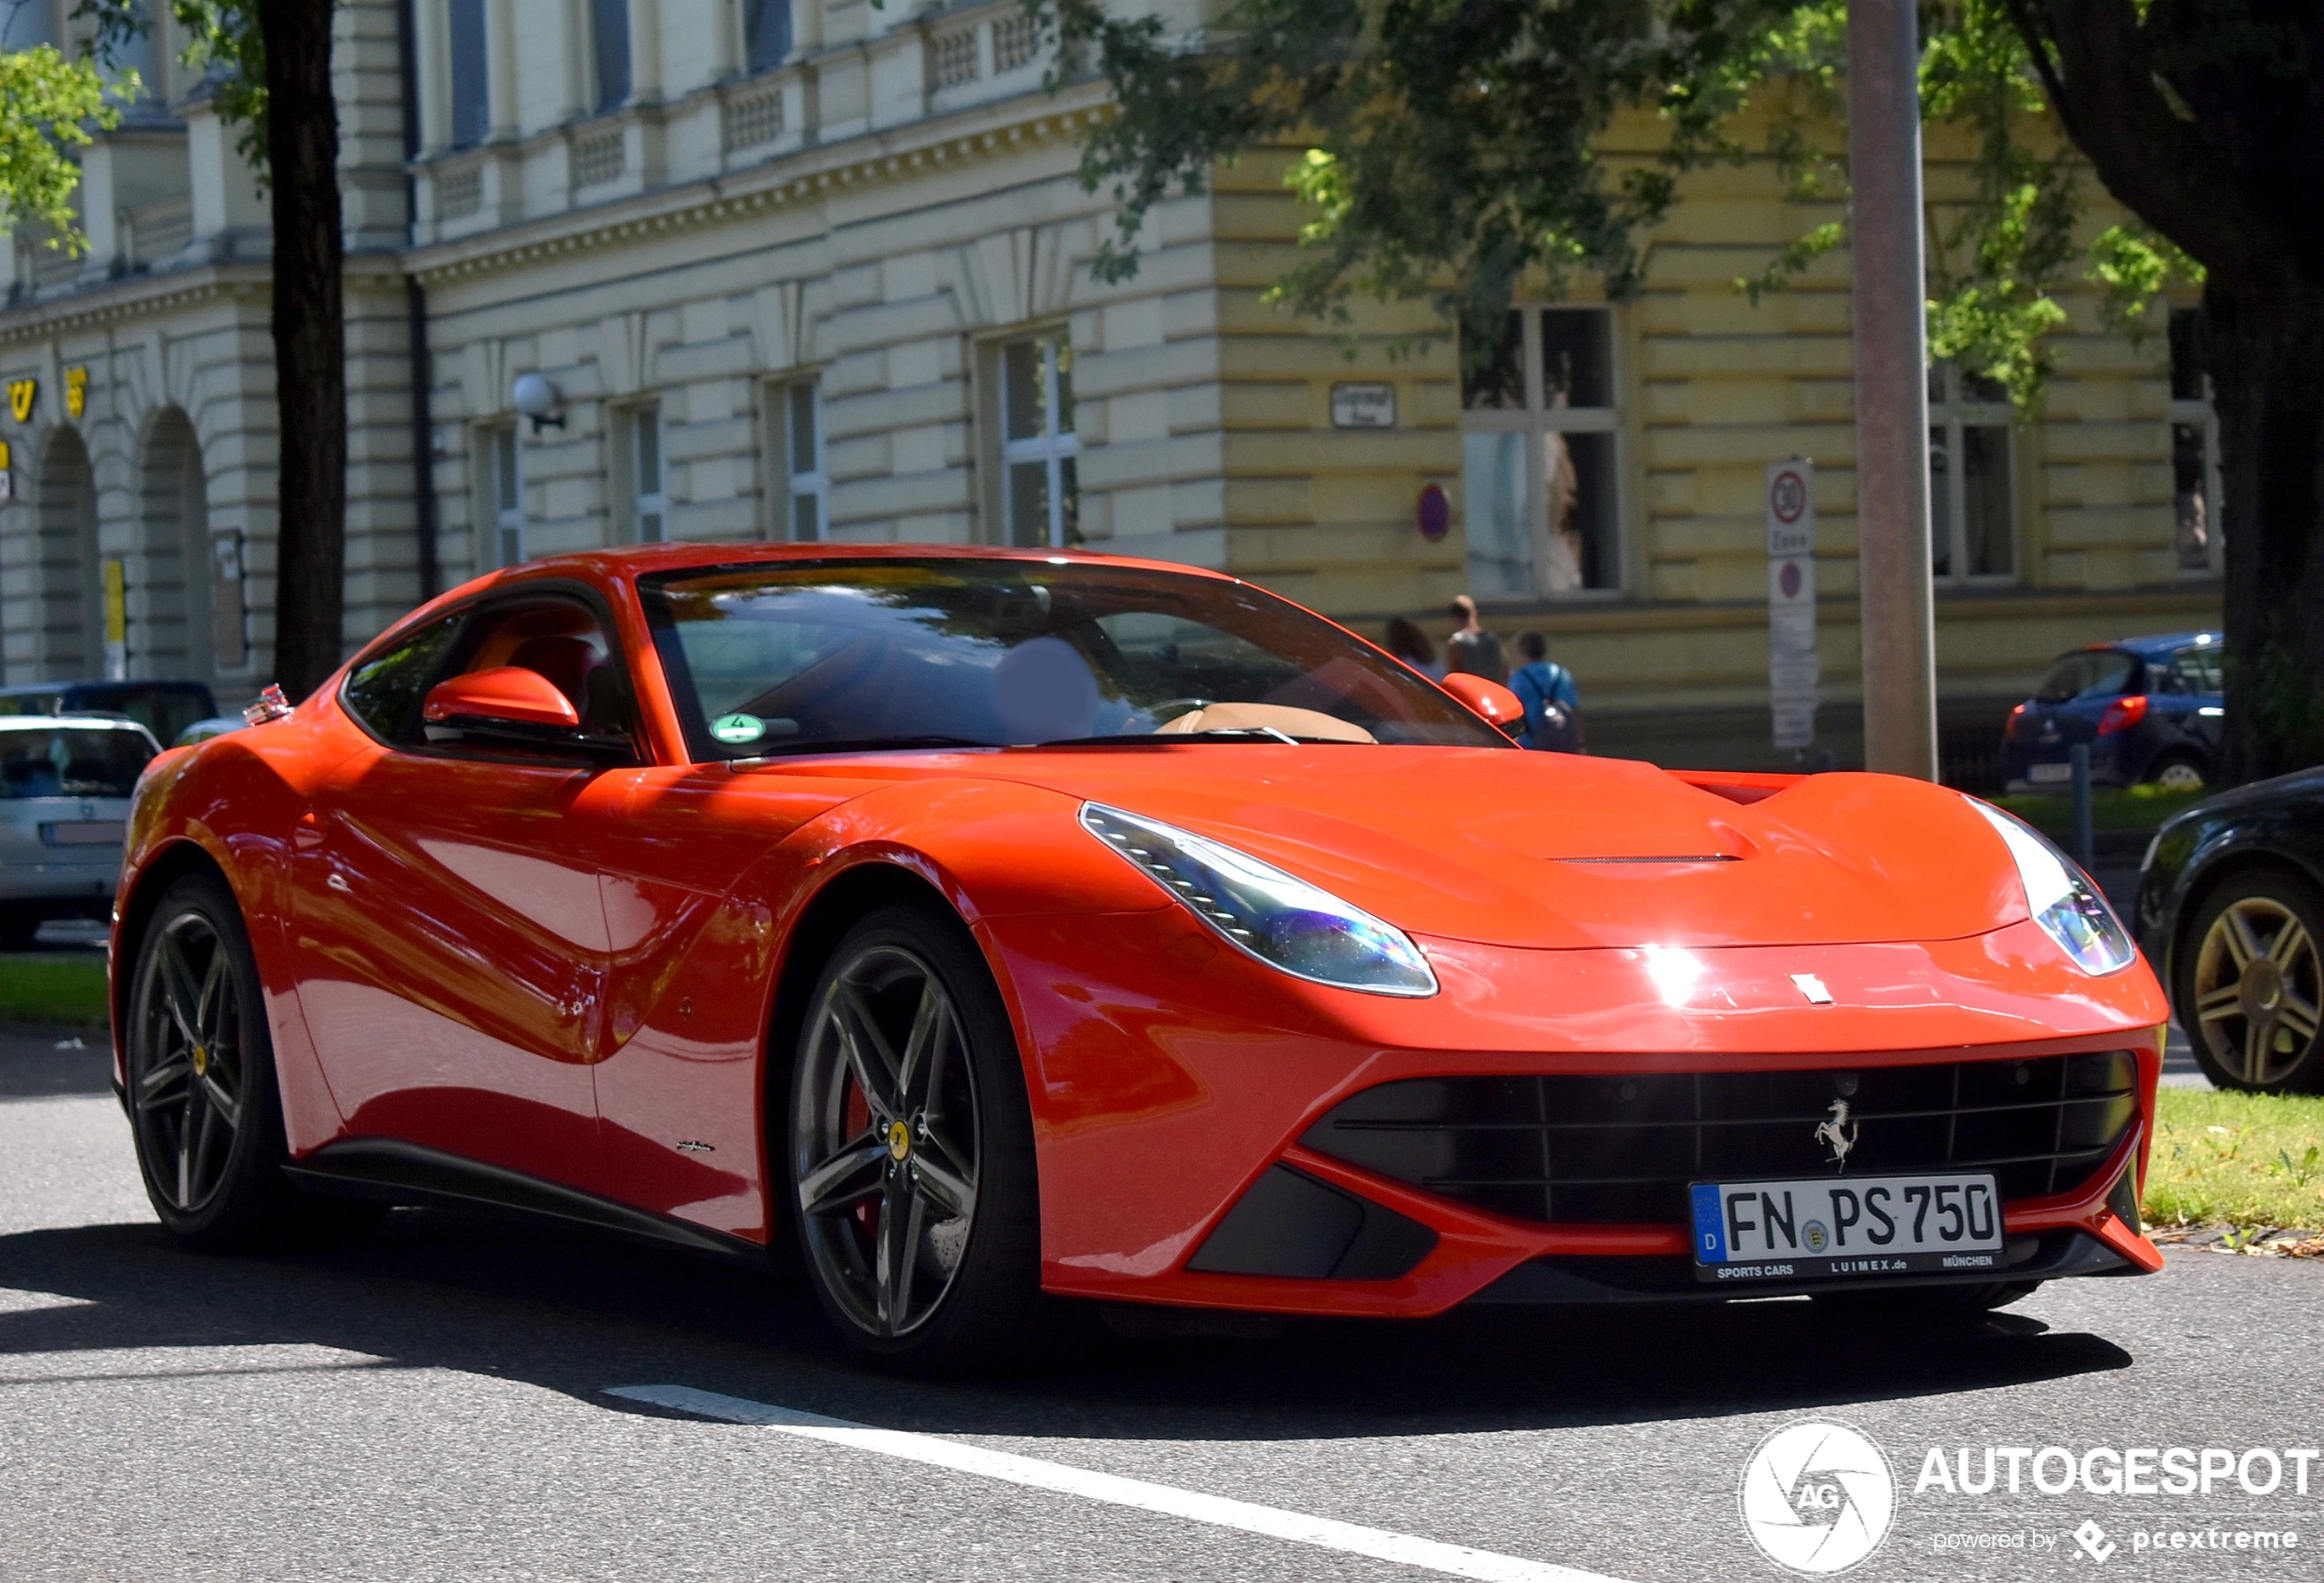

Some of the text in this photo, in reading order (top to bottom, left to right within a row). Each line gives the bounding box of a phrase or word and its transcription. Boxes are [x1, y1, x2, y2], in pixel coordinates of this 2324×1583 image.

[731, 716, 744, 727] 4
[1727, 1184, 1995, 1251] FN PS 750
[1705, 1233, 1716, 1250] D
[1943, 1255, 1993, 1266] MÜNCHEN
[1717, 1265, 1794, 1278] SPORTS CARS
